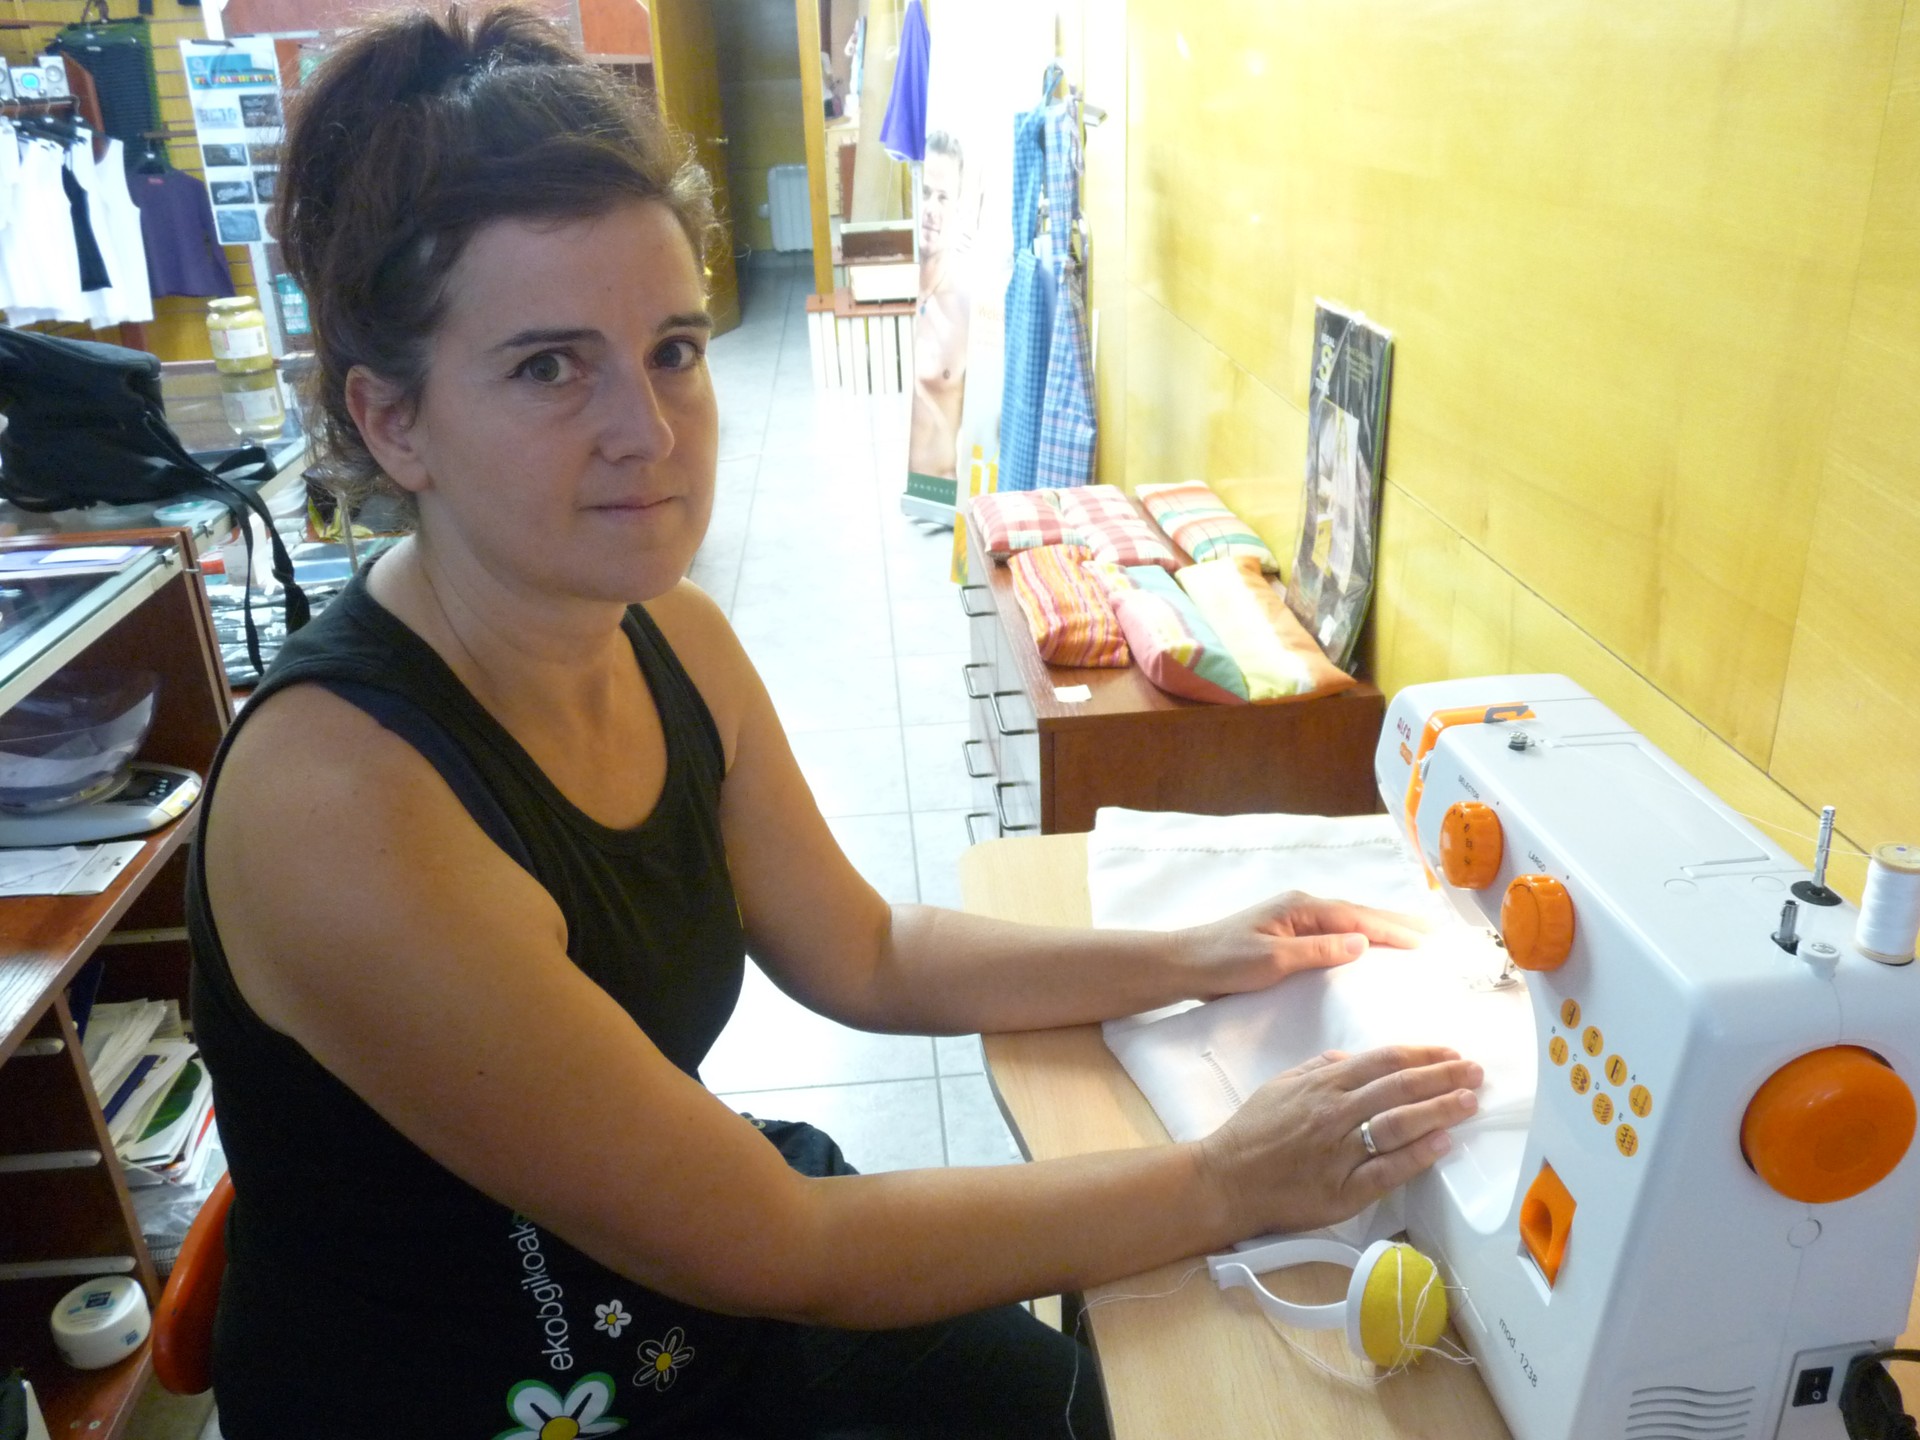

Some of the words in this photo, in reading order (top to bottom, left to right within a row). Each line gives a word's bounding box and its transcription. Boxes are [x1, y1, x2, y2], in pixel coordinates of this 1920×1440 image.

[1458, 774, 1480, 800] SELECTOR
[1528, 850, 1547, 873] LARGO
[1499, 1318, 1517, 1353] mod.
[1520, 1352, 1538, 1388] 1238
